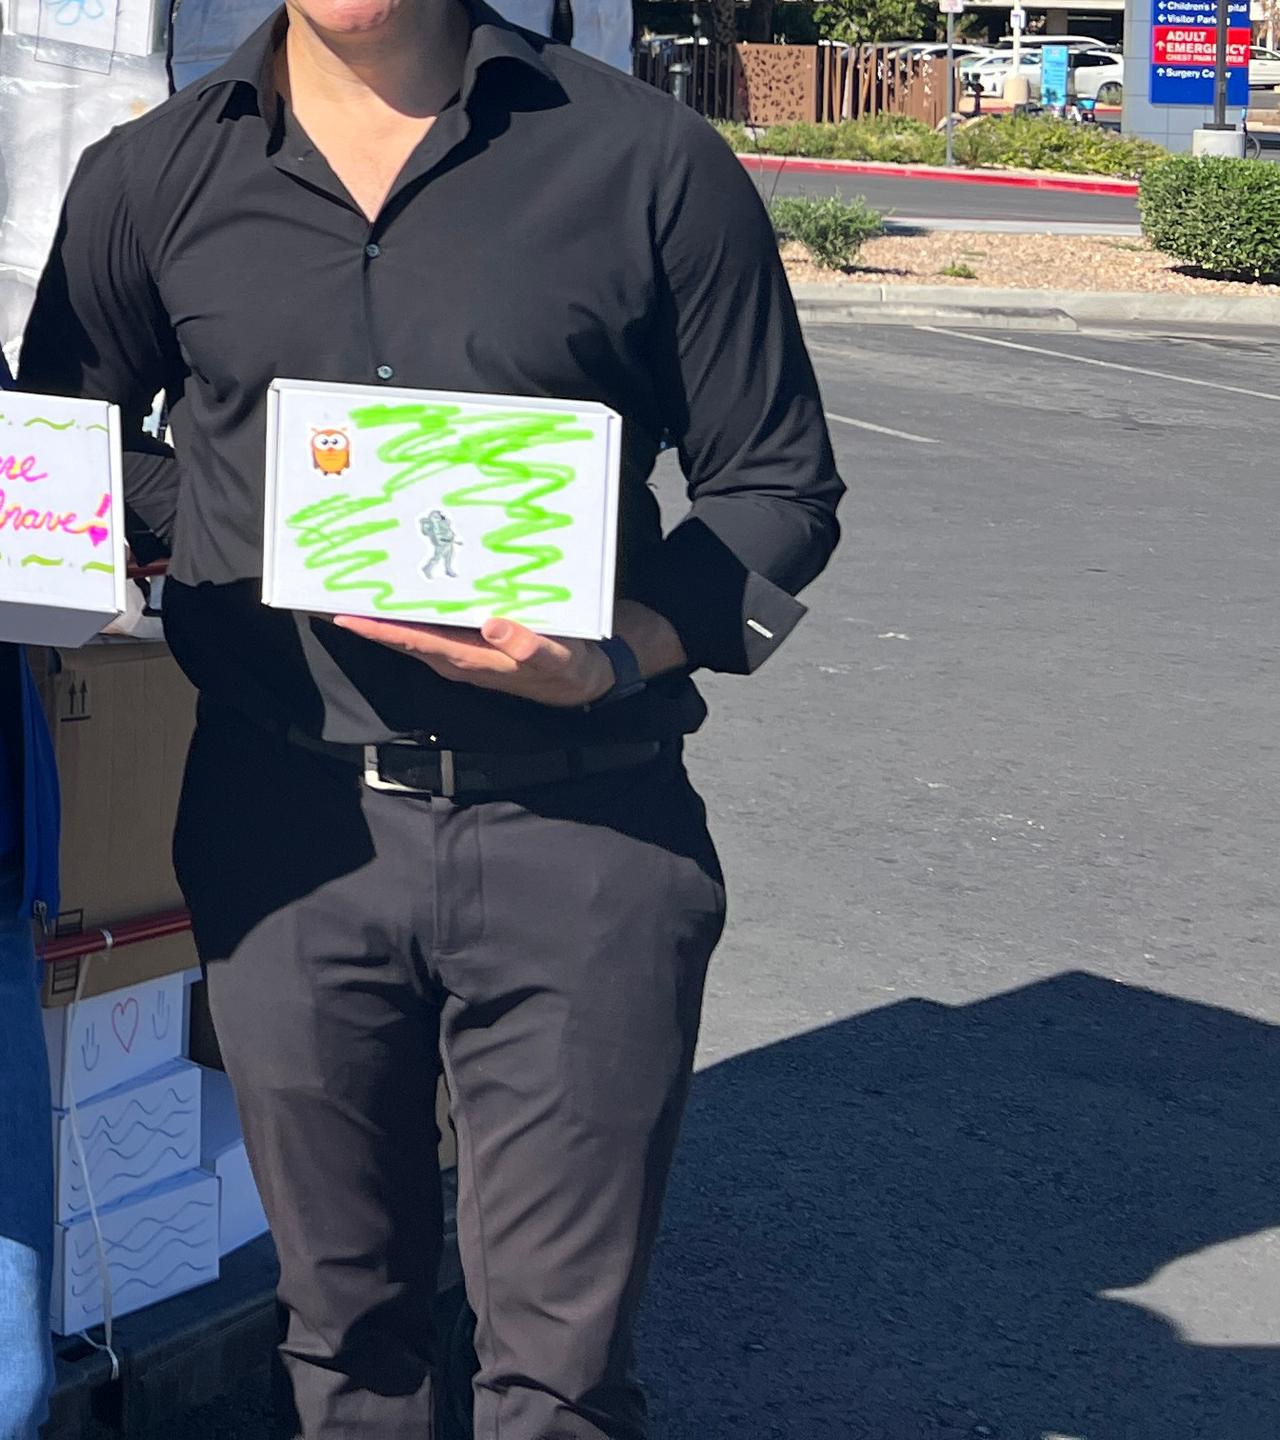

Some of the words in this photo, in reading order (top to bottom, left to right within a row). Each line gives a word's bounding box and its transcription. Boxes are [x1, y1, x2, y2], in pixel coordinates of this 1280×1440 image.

[1167, 1, 1209, 12] Children's
[1211, 2, 1247, 13] Hpital
[1167, 14, 1195, 24] Visitor
[1197, 15, 1231, 26] Parkg
[1166, 31, 1207, 41] ADULT
[1166, 43, 1247, 54] EMERGCY
[1166, 68, 1200, 79] Surgery
